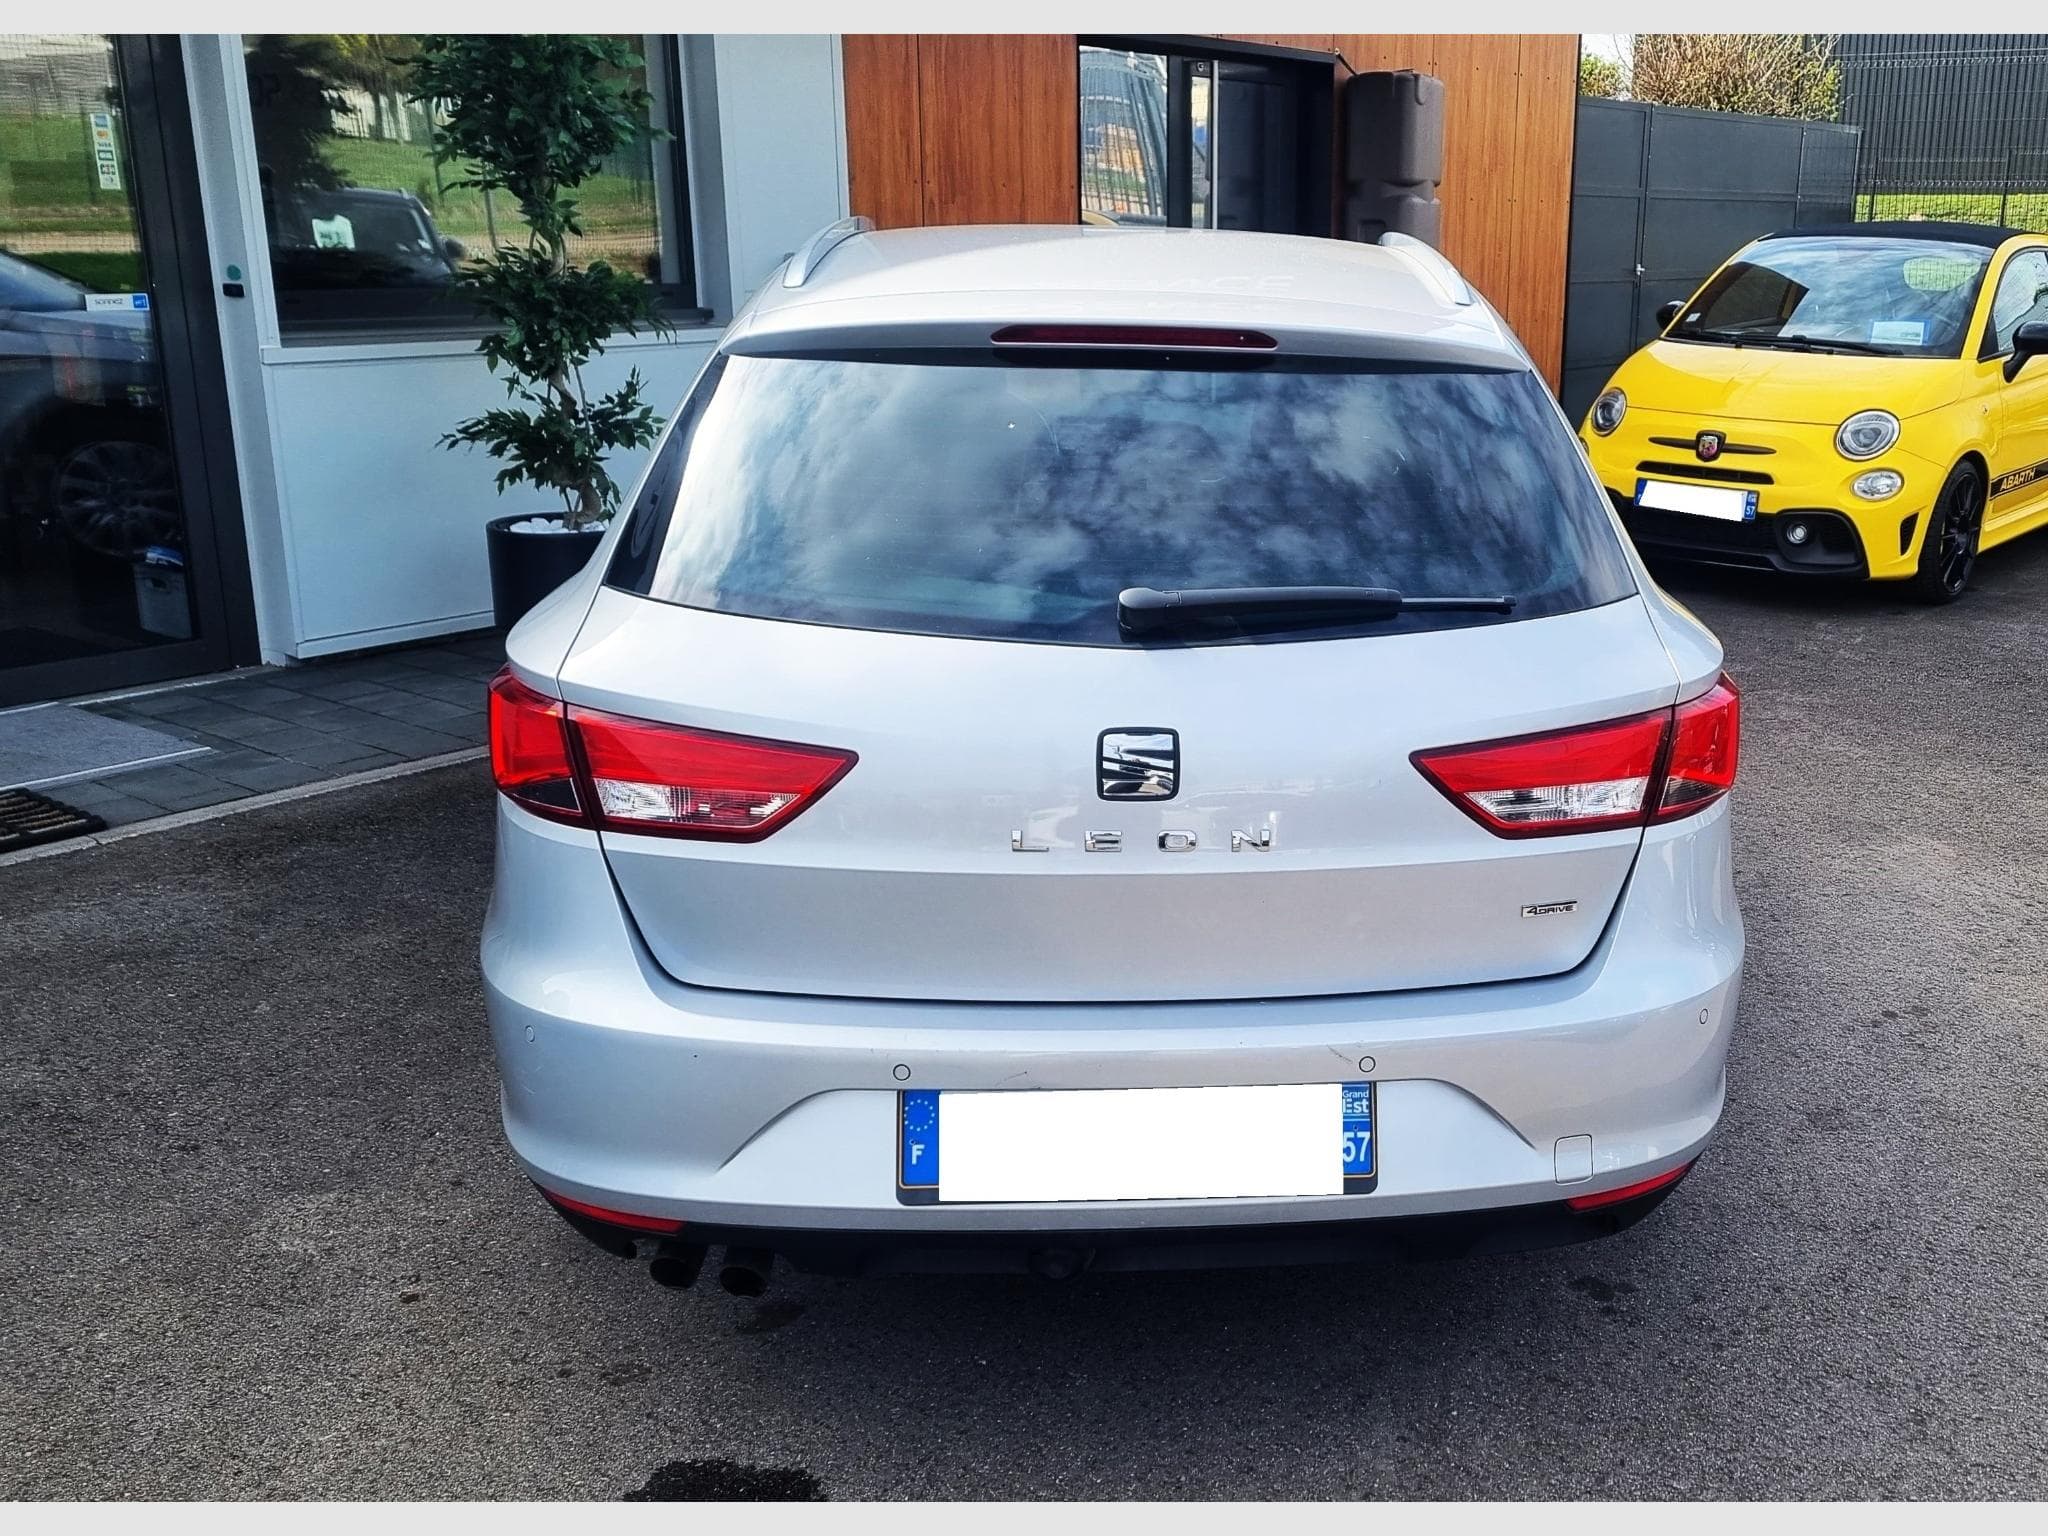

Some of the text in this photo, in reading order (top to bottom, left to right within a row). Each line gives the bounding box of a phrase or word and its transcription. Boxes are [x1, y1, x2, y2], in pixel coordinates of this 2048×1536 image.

[2000, 467, 2036, 491] ABARTH
[1745, 505, 1755, 515] 57
[1011, 829, 1271, 853] LEON
[1342, 1089, 1369, 1099] Grand
[1342, 1099, 1369, 1114] Est
[911, 1144, 925, 1165] F
[1343, 1131, 1371, 1163] 57
